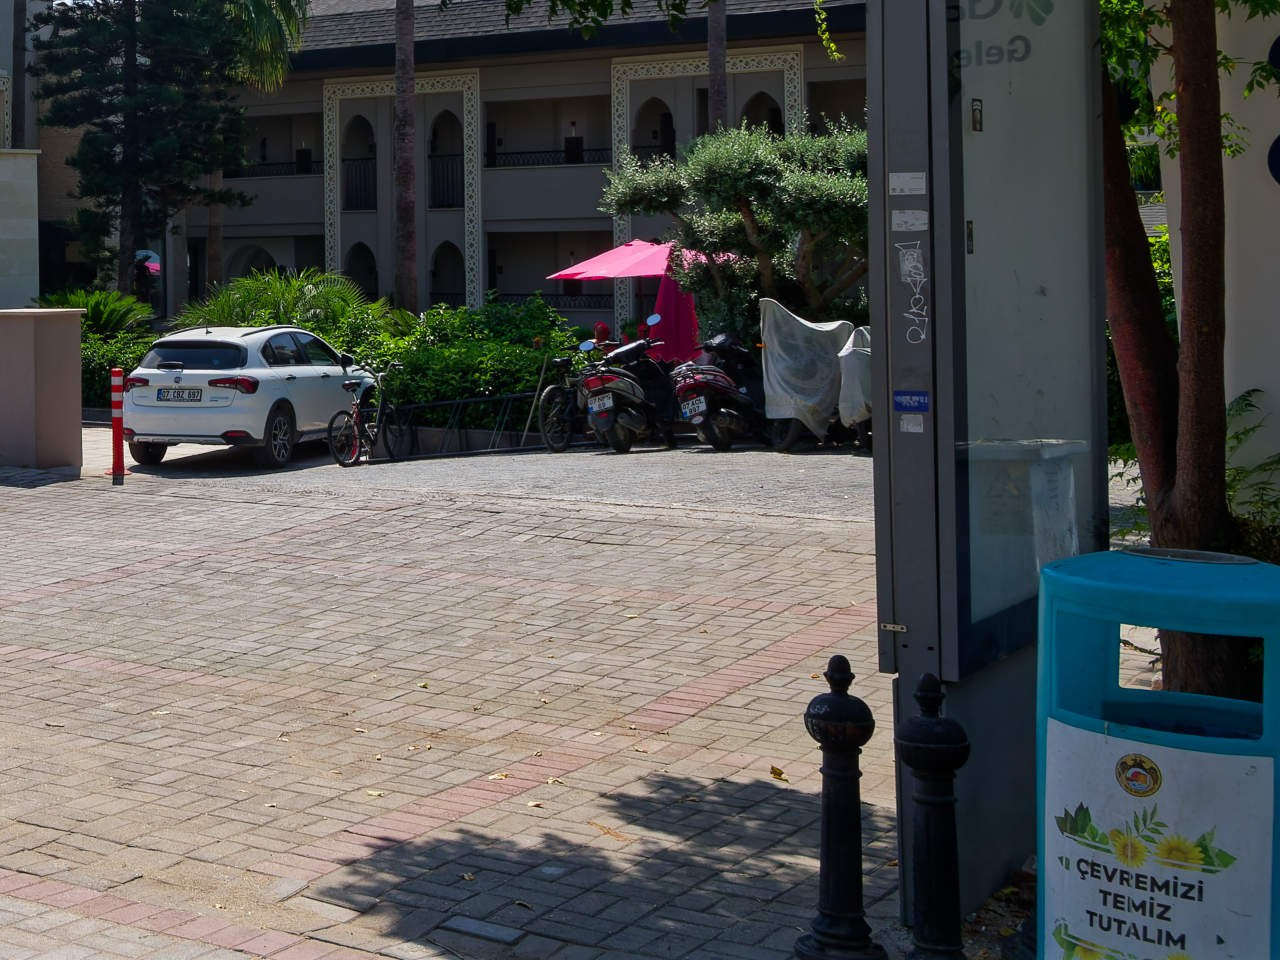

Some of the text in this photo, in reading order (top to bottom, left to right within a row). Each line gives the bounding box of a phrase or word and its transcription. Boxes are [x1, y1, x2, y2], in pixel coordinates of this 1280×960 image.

[1076, 858, 1204, 902] ÇEVREMİZİ
[1099, 889, 1172, 922] TEMİZ
[1086, 909, 1186, 951] TUTALIM
